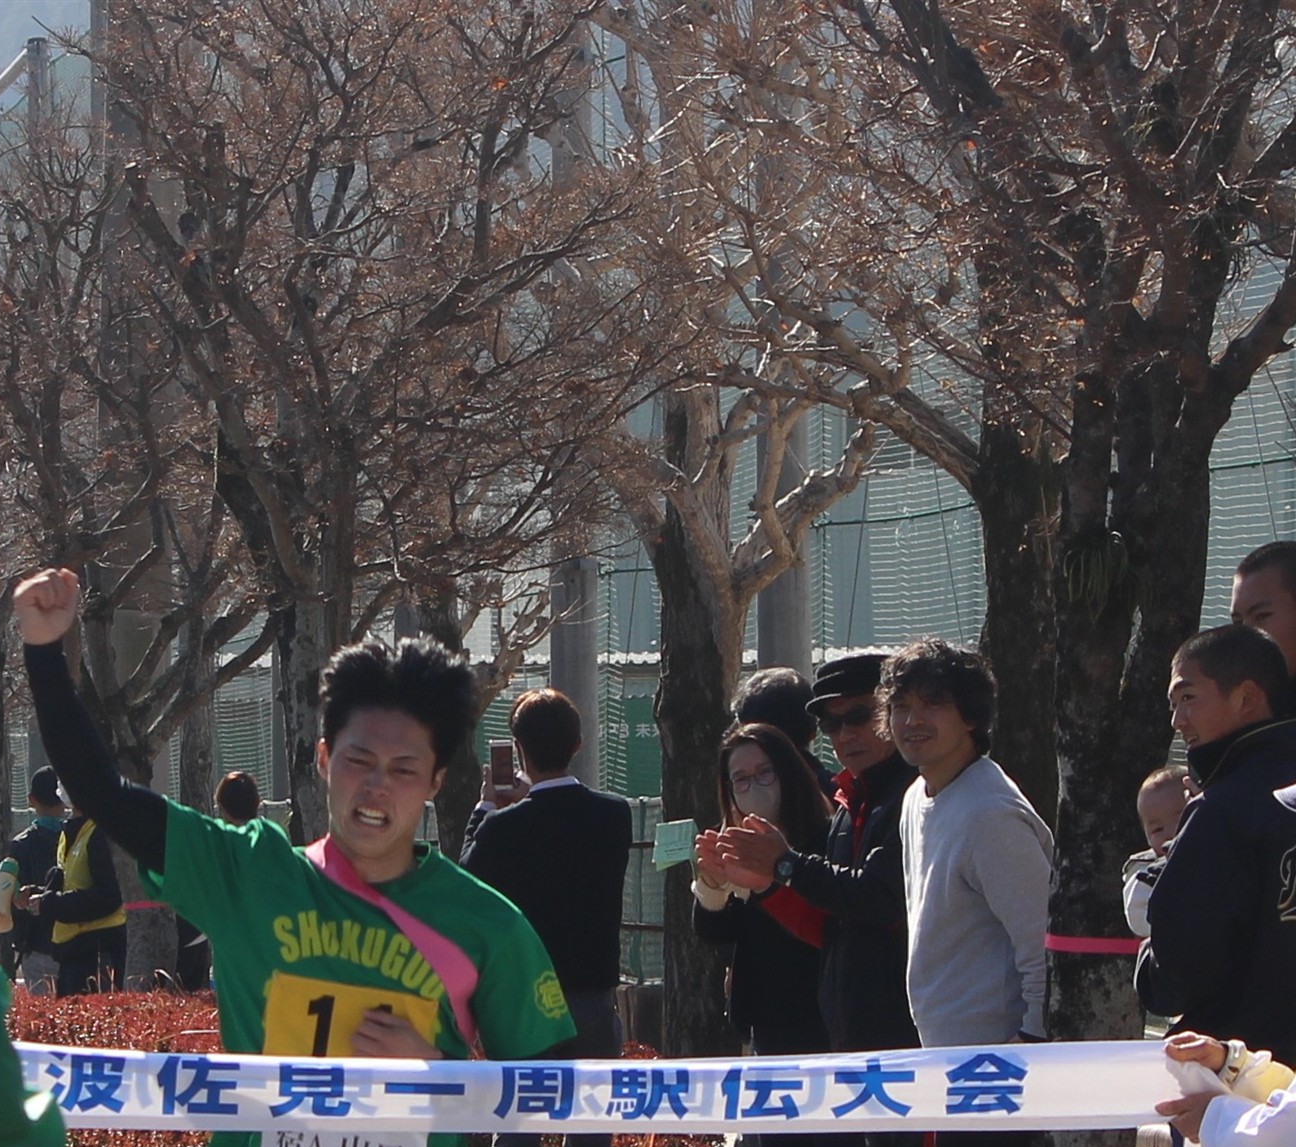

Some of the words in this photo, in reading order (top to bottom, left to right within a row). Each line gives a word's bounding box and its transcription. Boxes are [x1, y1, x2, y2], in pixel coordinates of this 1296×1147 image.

[307, 994, 394, 1058] 1
[45, 1052, 1028, 1120] 波佐見一周駅伝大会
